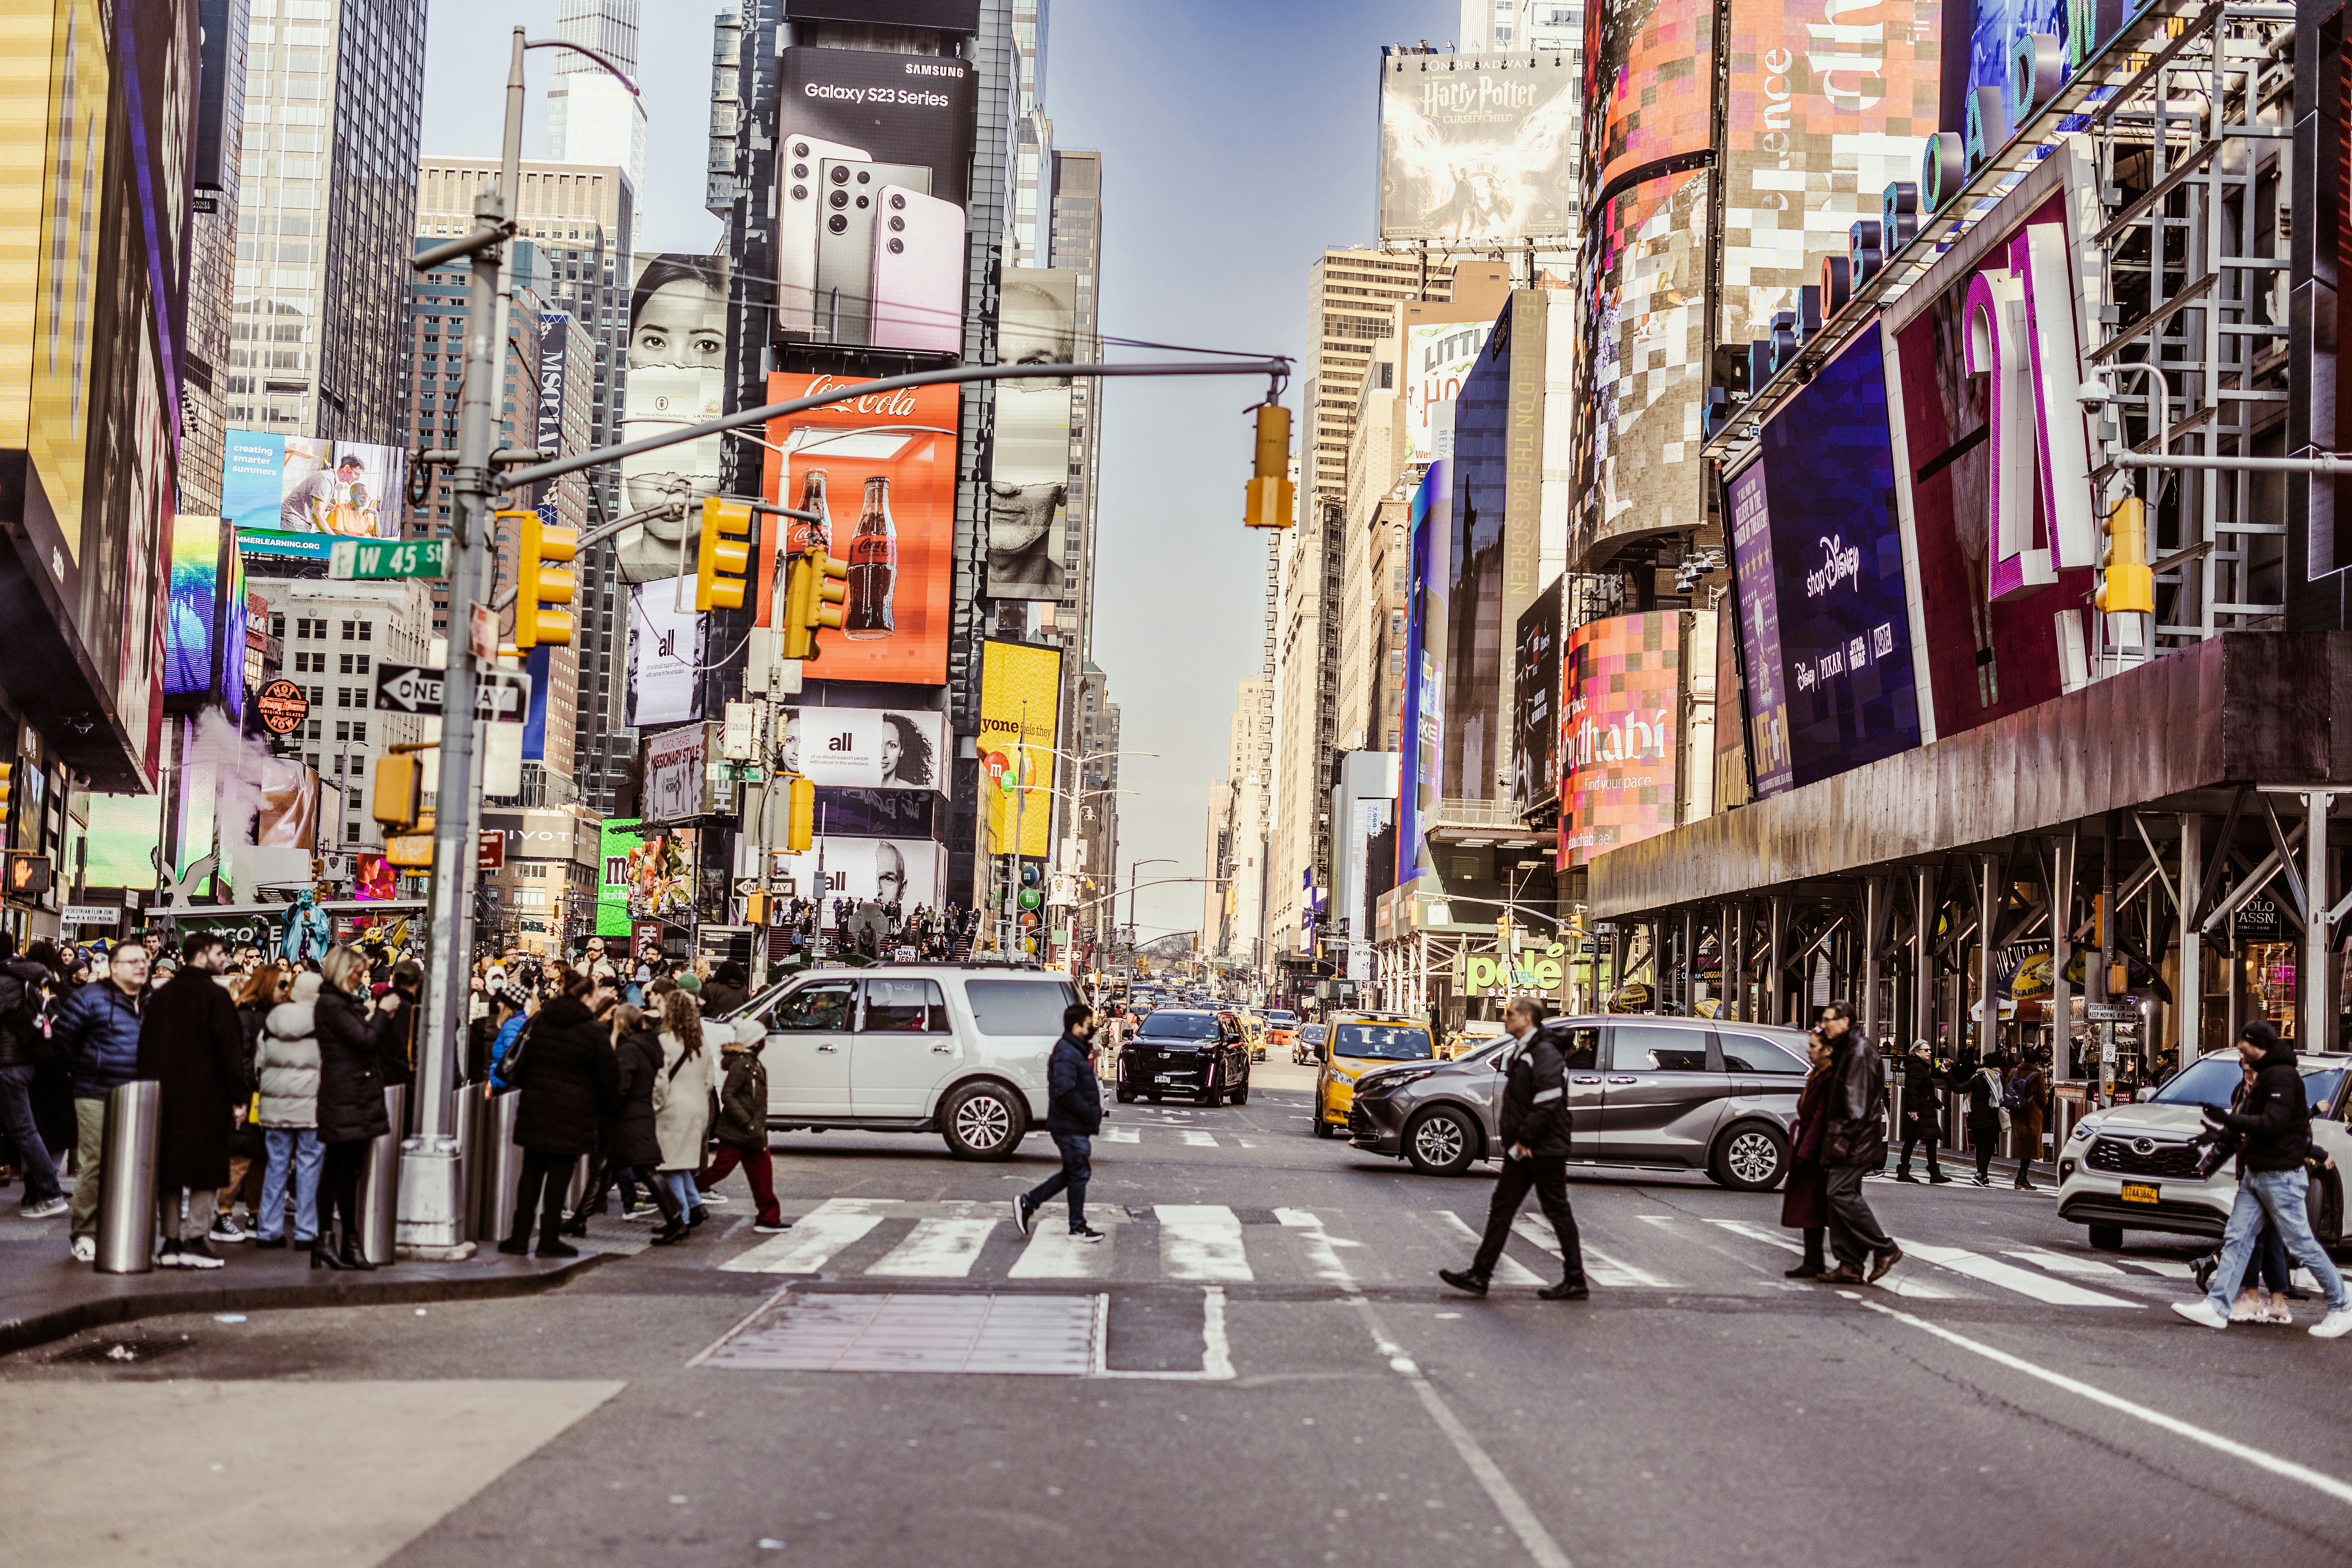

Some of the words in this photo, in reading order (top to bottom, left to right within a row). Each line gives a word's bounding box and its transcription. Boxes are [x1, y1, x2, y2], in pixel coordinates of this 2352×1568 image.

[906, 63, 964, 78] SAMSUNG
[805, 83, 866, 104] Galaxy
[867, 87, 895, 103] S23
[898, 90, 949, 107] Series
[1419, 81, 1477, 117] Harry
[1478, 76, 1537, 119] Potter
[1443, 115, 1481, 124] CURSED
[1483, 114, 1513, 122] CHILD
[1425, 328, 1494, 373] LITTL
[233, 445, 274, 457] creating
[1513, 433, 1533, 473] THE
[233, 456, 271, 466] smarter
[232, 466, 277, 476] summers
[359, 547, 381, 574] W
[389, 545, 417, 574] 45
[426, 544, 441, 563] St
[1807, 569, 1825, 597] shop
[1819, 533, 1860, 592] Disney
[659, 629, 675, 657] all
[1850, 635, 1864, 653] STAR
[1820, 650, 1842, 679] PIXAR
[1849, 648, 1866, 670] WARS
[273, 685, 295, 696] HOT
[400, 681, 441, 701] ONE
[270, 716, 294, 729] NOW
[981, 718, 1019, 733] yone
[1036, 724, 1051, 740] they
[661, 739, 675, 750] MUSICAL
[676, 735, 690, 747] THEATER
[829, 732, 852, 751] all
[1751, 710, 1774, 777] LIFE
[1769, 719, 1779, 762] OF
[1778, 702, 1791, 768] PI
[651, 748, 682, 771] MISSIONARY
[682, 744, 700, 764] STYLE
[720, 766, 730, 779] W
[735, 767, 748, 779] 45
[990, 763, 1002, 777] m
[1005, 777, 1012, 785] m
[1585, 775, 1599, 791] Find
[1600, 778, 1622, 793] your
[1624, 776, 1652, 791] pace
[825, 871, 846, 891] all
[2238, 913, 2278, 924] ASSN.
